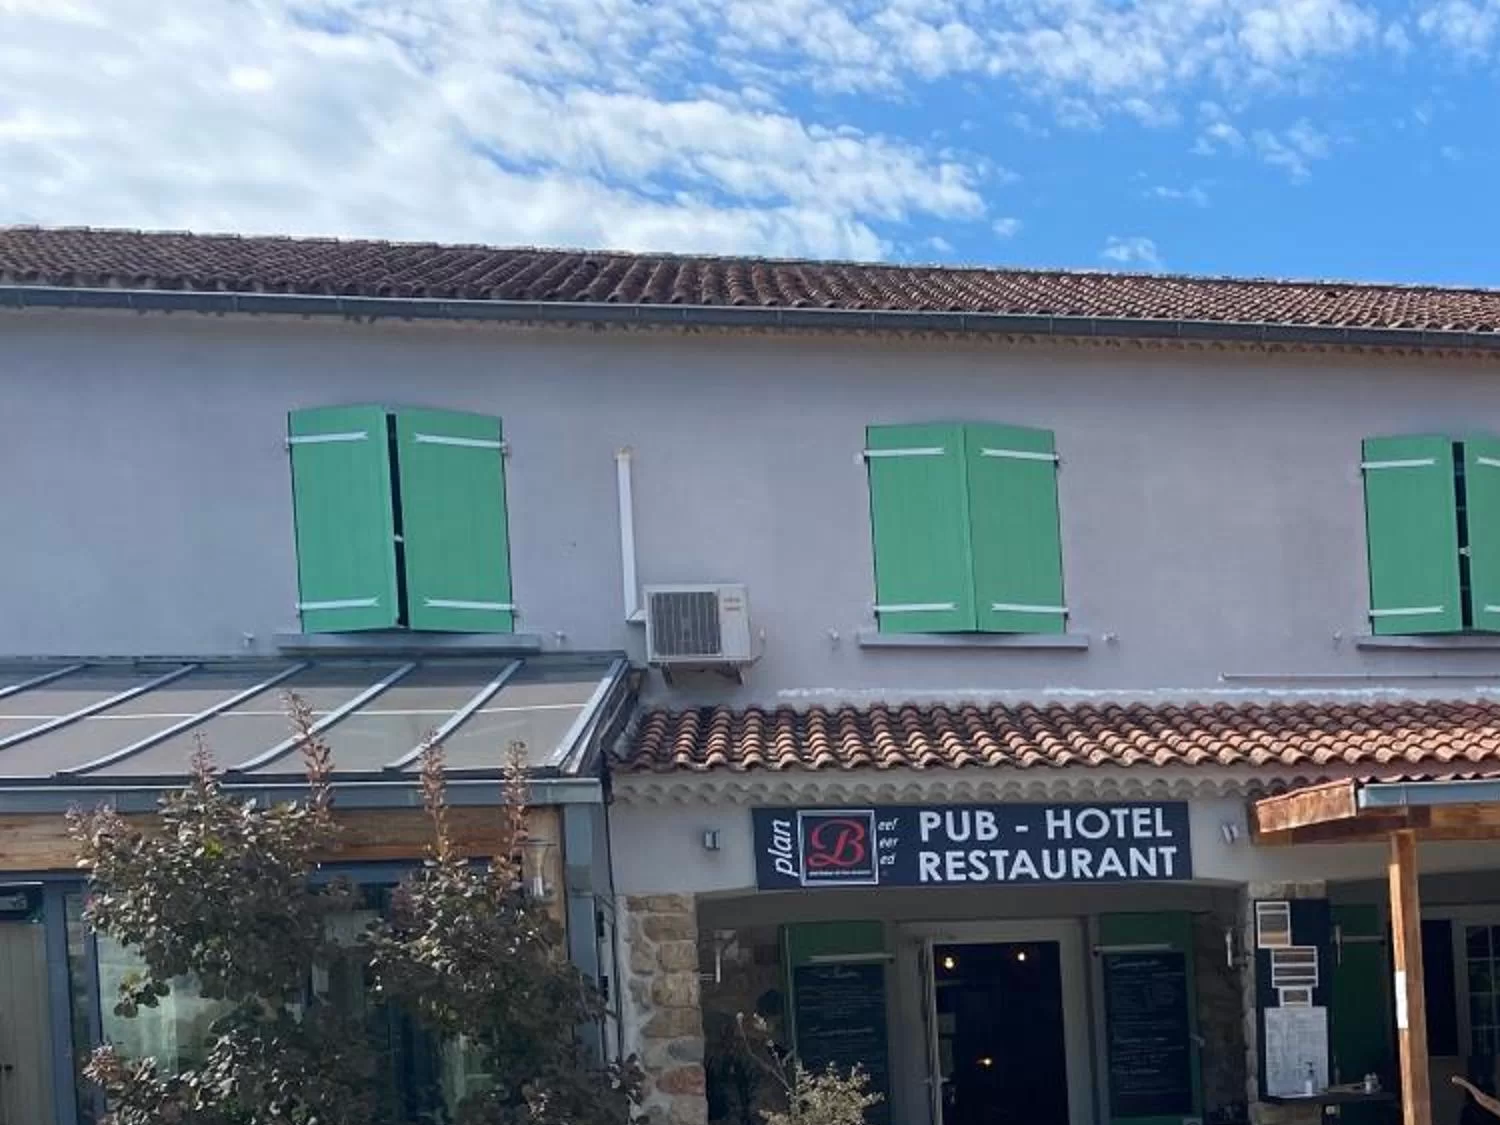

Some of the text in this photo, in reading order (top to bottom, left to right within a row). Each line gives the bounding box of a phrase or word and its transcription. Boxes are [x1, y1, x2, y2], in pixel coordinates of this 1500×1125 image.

[807, 818, 865, 868] B
[919, 810, 999, 842] PUB
[1045, 807, 1173, 840] HOTEL
[767, 818, 799, 877] plan
[919, 846, 1177, 882] RESTAURANT
